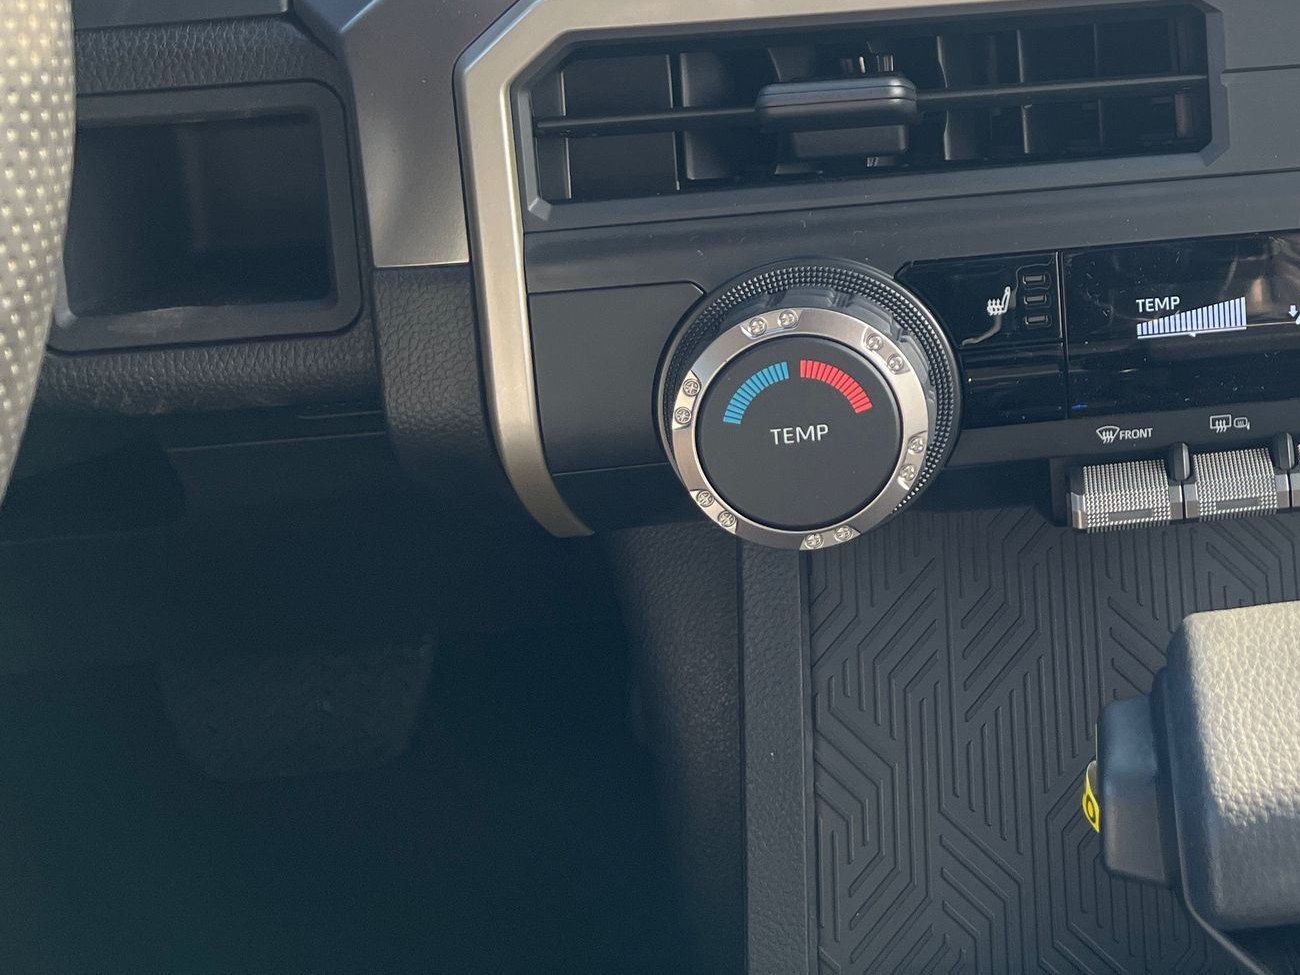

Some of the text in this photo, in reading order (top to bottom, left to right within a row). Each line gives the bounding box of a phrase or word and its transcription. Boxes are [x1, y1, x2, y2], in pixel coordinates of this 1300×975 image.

[1136, 296, 1180, 312] TEMP
[770, 424, 829, 445] TEMP
[1120, 428, 1153, 440] FRONT
